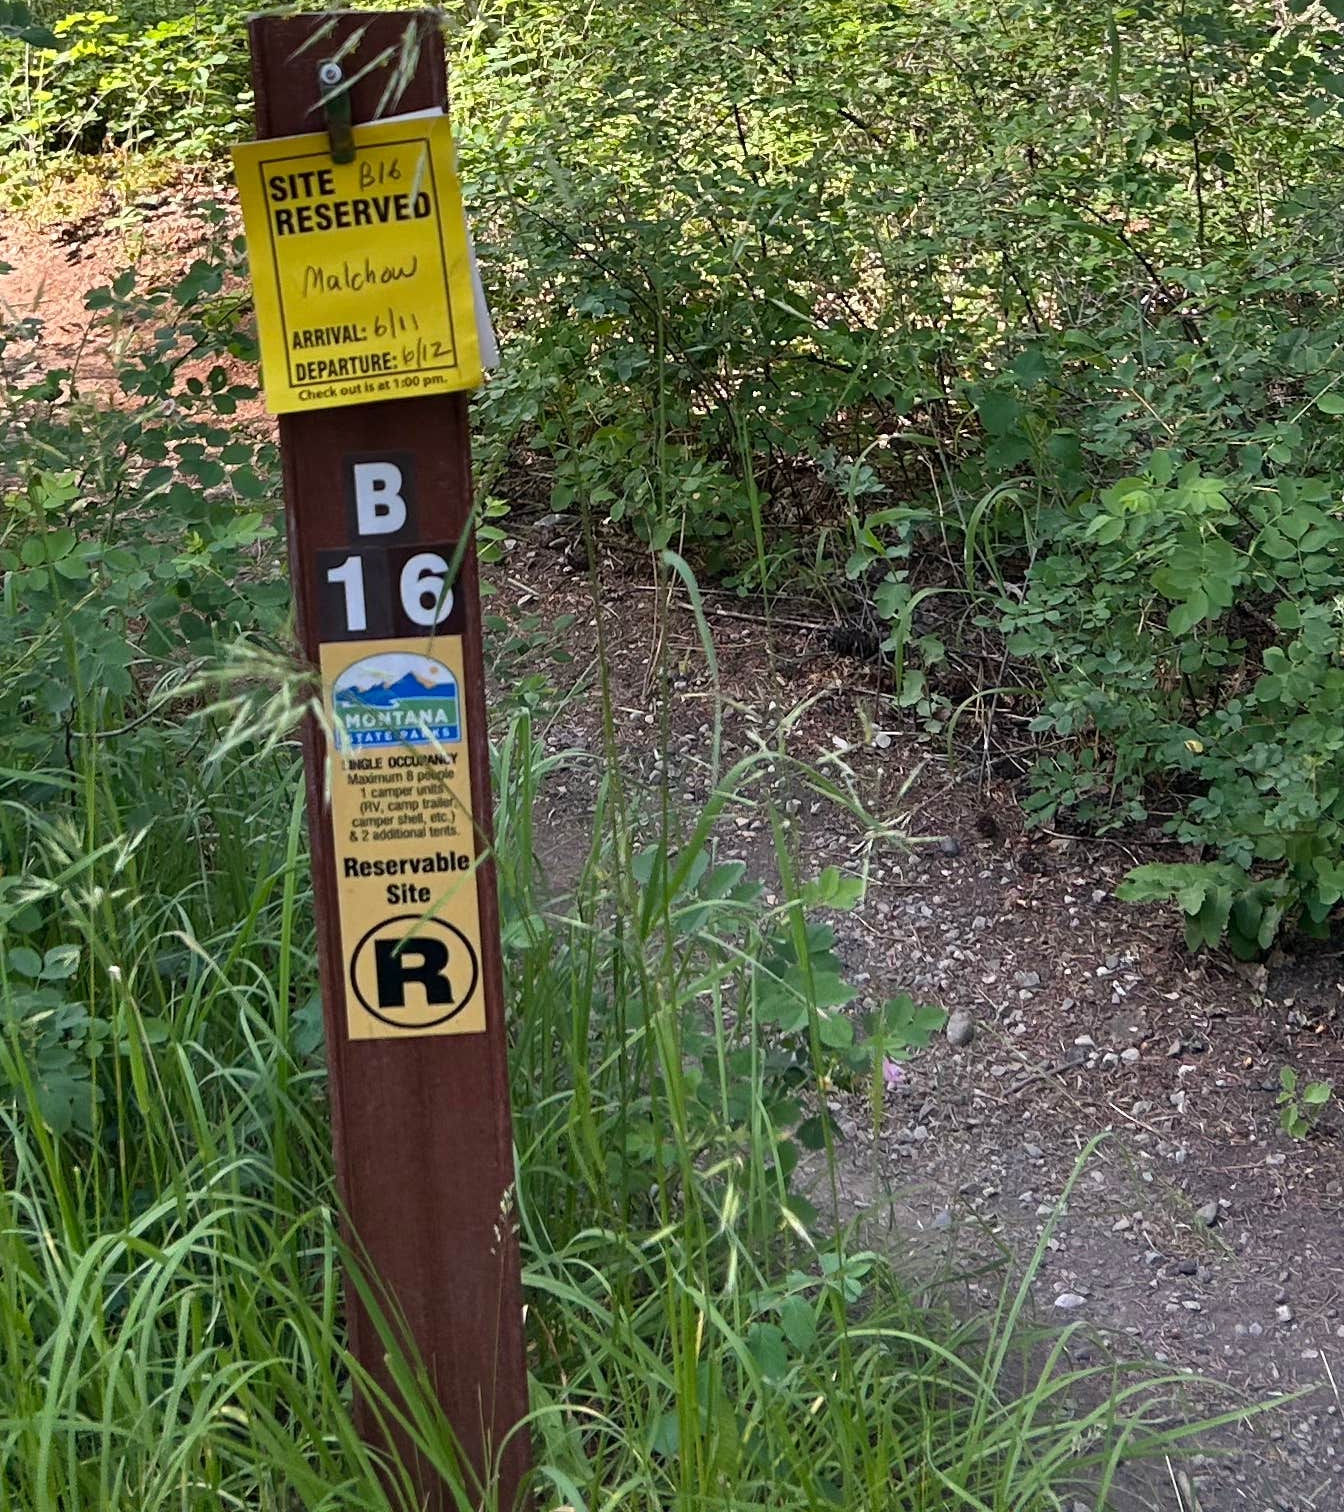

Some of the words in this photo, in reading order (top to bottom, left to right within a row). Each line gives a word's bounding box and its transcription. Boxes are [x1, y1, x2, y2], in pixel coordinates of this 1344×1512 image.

[269, 169, 336, 202] SITE
[359, 158, 402, 191] B16
[274, 192, 432, 236] RESERVED
[303, 255, 418, 298] Malchow
[374, 307, 419, 338] 6/11
[292, 324, 367, 350] ARRIVAL:
[402, 337, 452, 368] 6/12
[295, 352, 398, 382] DEPARTURE:
[298, 386, 338, 402] Check
[341, 384, 361, 396] out
[364, 382, 375, 393] is
[378, 379, 390, 391] at
[394, 375, 420, 388] 1:00
[423, 374, 448, 388] pm.
[354, 462, 407, 535] B
[327, 553, 454, 631] 16
[345, 708, 449, 729] MONTANA
[348, 730, 393, 743] TATE
[347, 771, 403, 785] Maximum
[406, 770, 414, 781] 8
[361, 787, 367, 798] 1
[371, 786, 413, 799] camper
[352, 816, 394, 829] camper
[397, 812, 427, 825] shell,
[360, 800, 385, 815] (RV,
[388, 799, 419, 812] camp
[349, 830, 358, 842] &
[362, 830, 369, 842] 2
[373, 827, 426, 841] additional
[430, 825, 460, 837] tents.
[343, 851, 470, 878] Reservable
[386, 883, 431, 905] Site
[374, 936, 455, 1008] R
